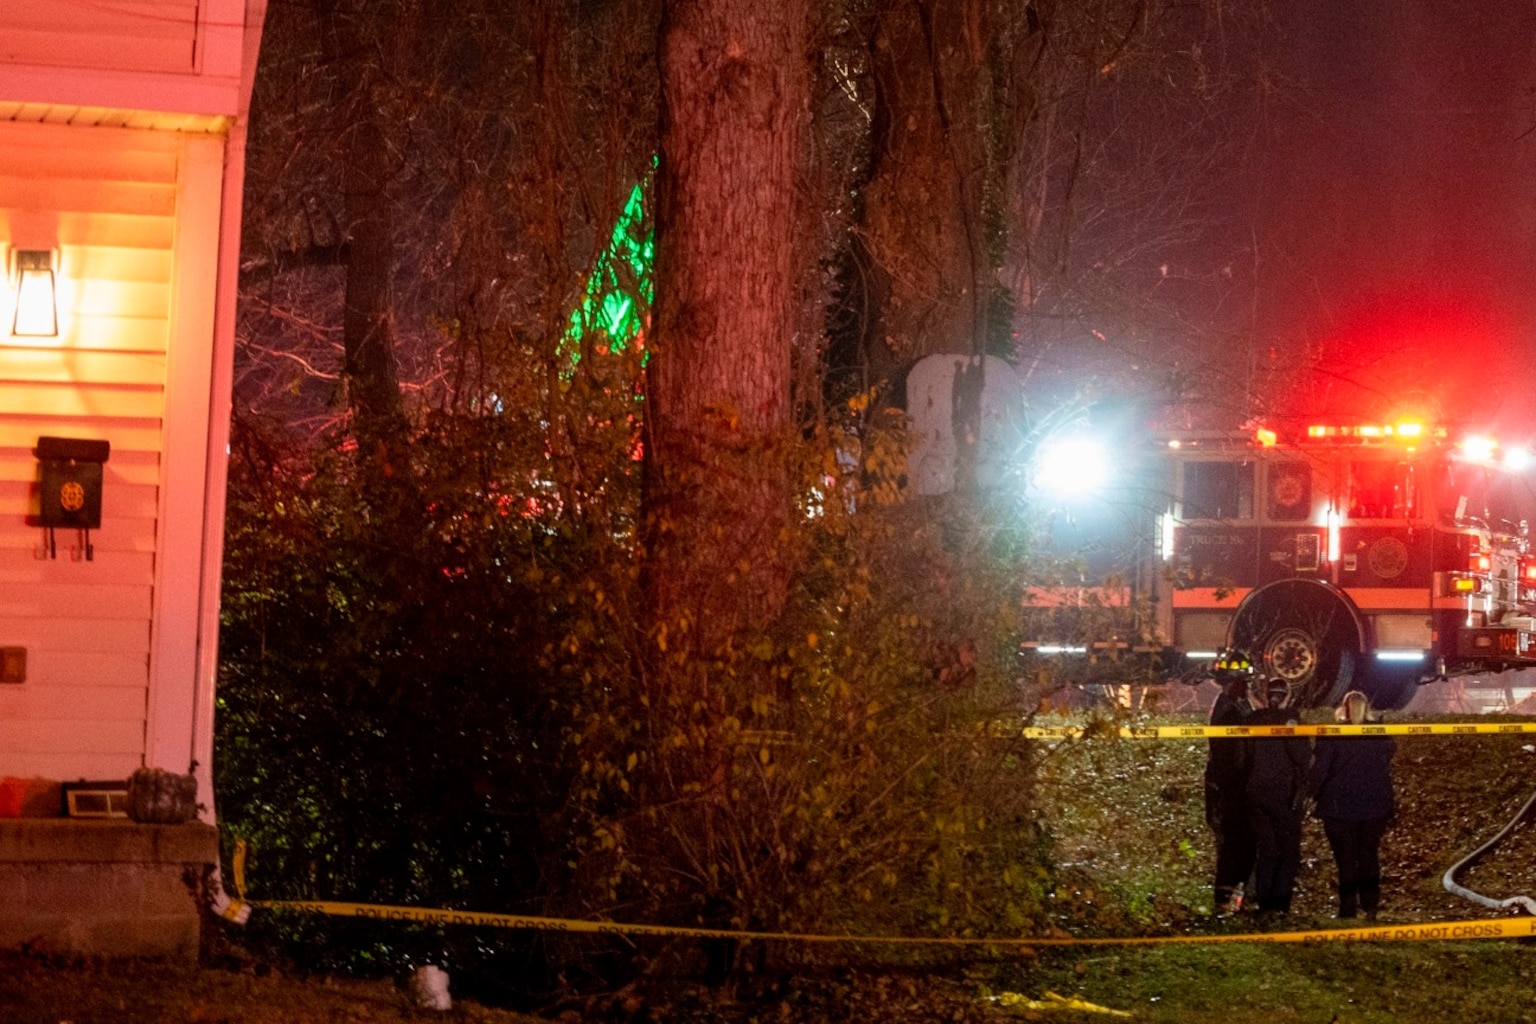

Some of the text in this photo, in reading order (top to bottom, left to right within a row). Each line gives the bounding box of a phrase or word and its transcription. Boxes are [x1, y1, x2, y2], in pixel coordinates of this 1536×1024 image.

[1394, 929, 1416, 941] DO
[1420, 927, 1450, 939] NOT
[1452, 924, 1503, 938] CROSS
